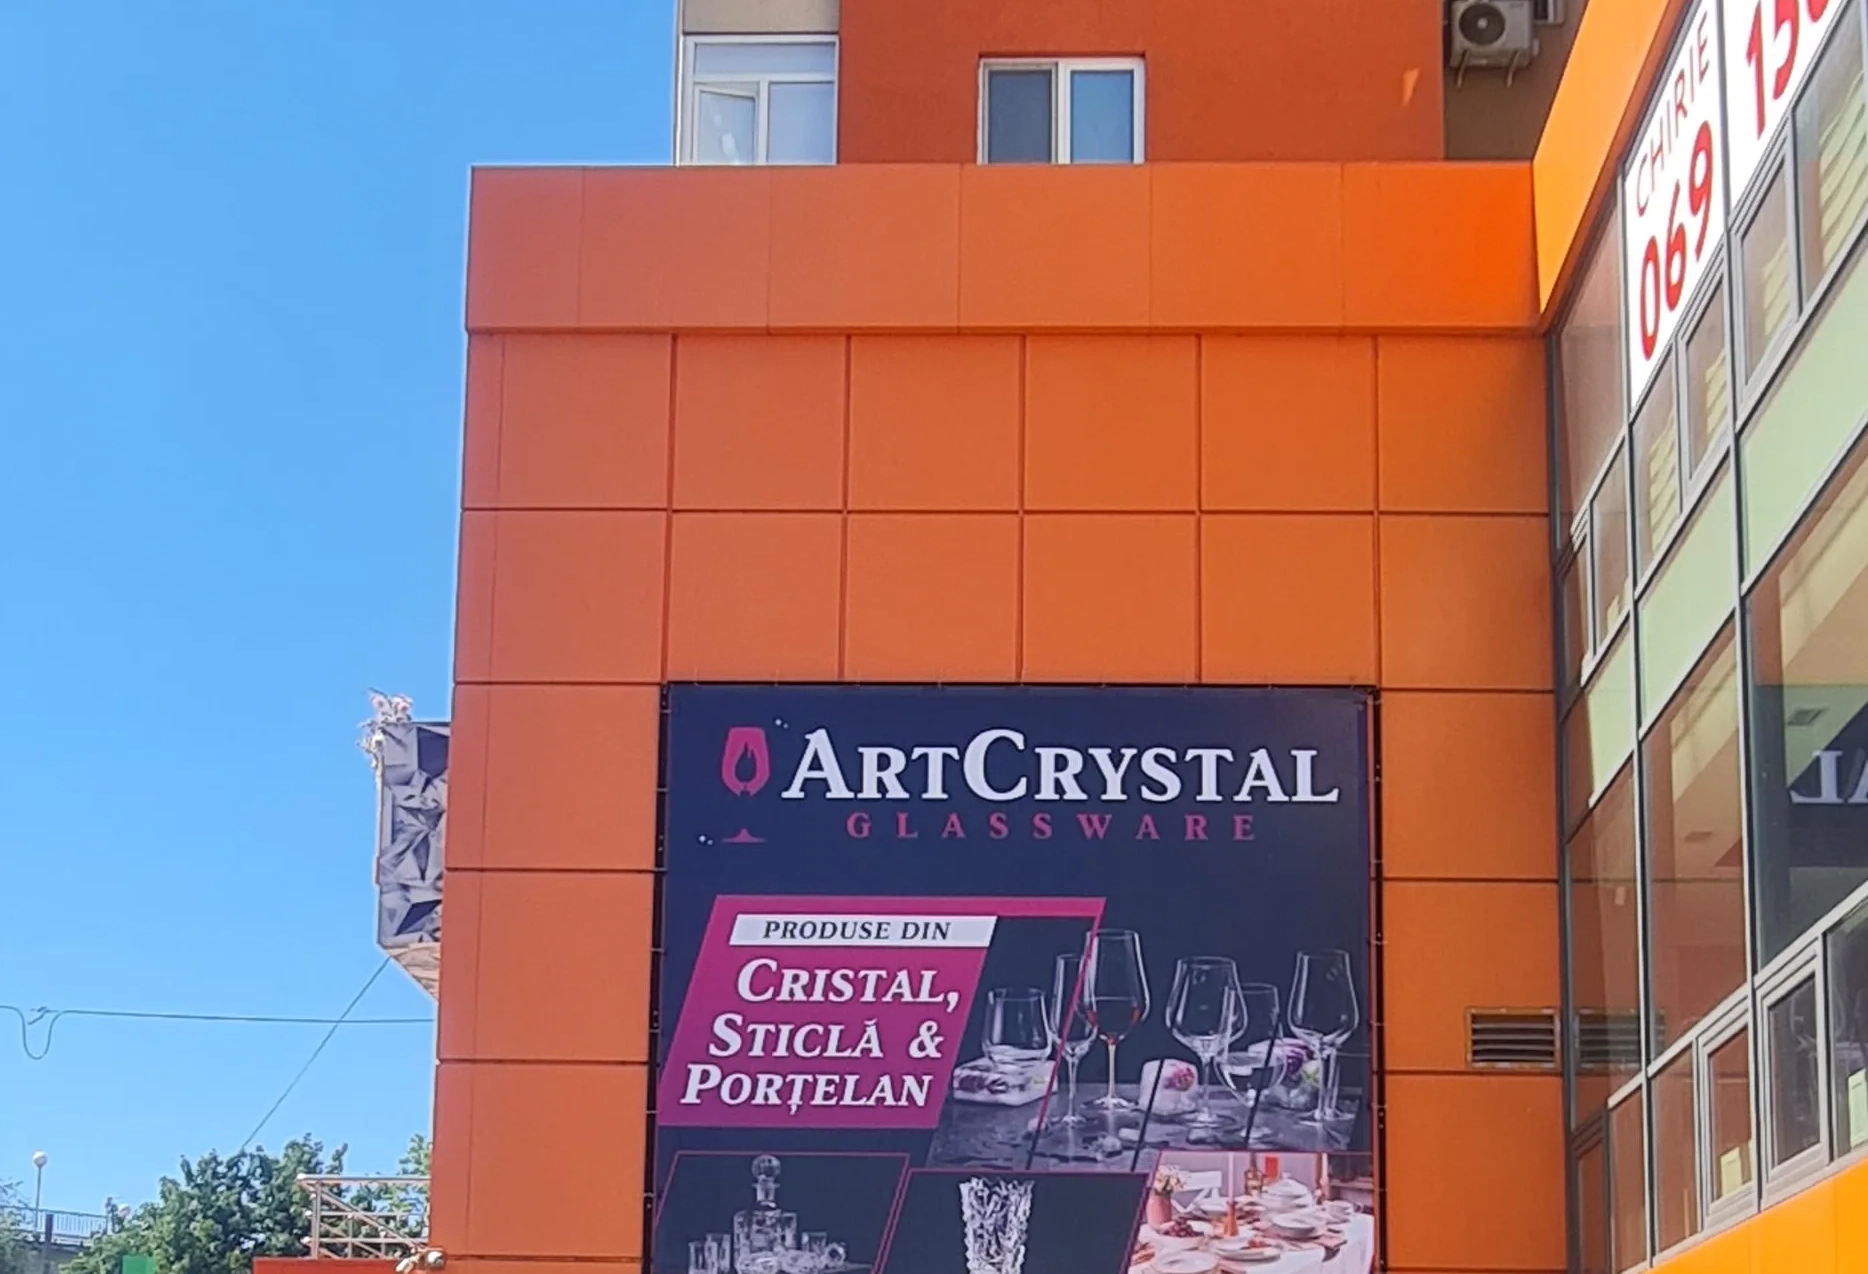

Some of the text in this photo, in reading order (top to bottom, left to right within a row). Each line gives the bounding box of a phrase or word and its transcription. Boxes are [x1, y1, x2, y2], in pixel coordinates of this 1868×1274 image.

[1636, 10, 1710, 218] CHIRIE
[1640, 0, 1829, 361] 069 15
[846, 813, 1256, 841] GLASSWARE
[762, 921, 952, 940] PRODUSE DIN
[736, 957, 961, 1013] CRISTAL,
[908, 1020, 945, 1058] &
